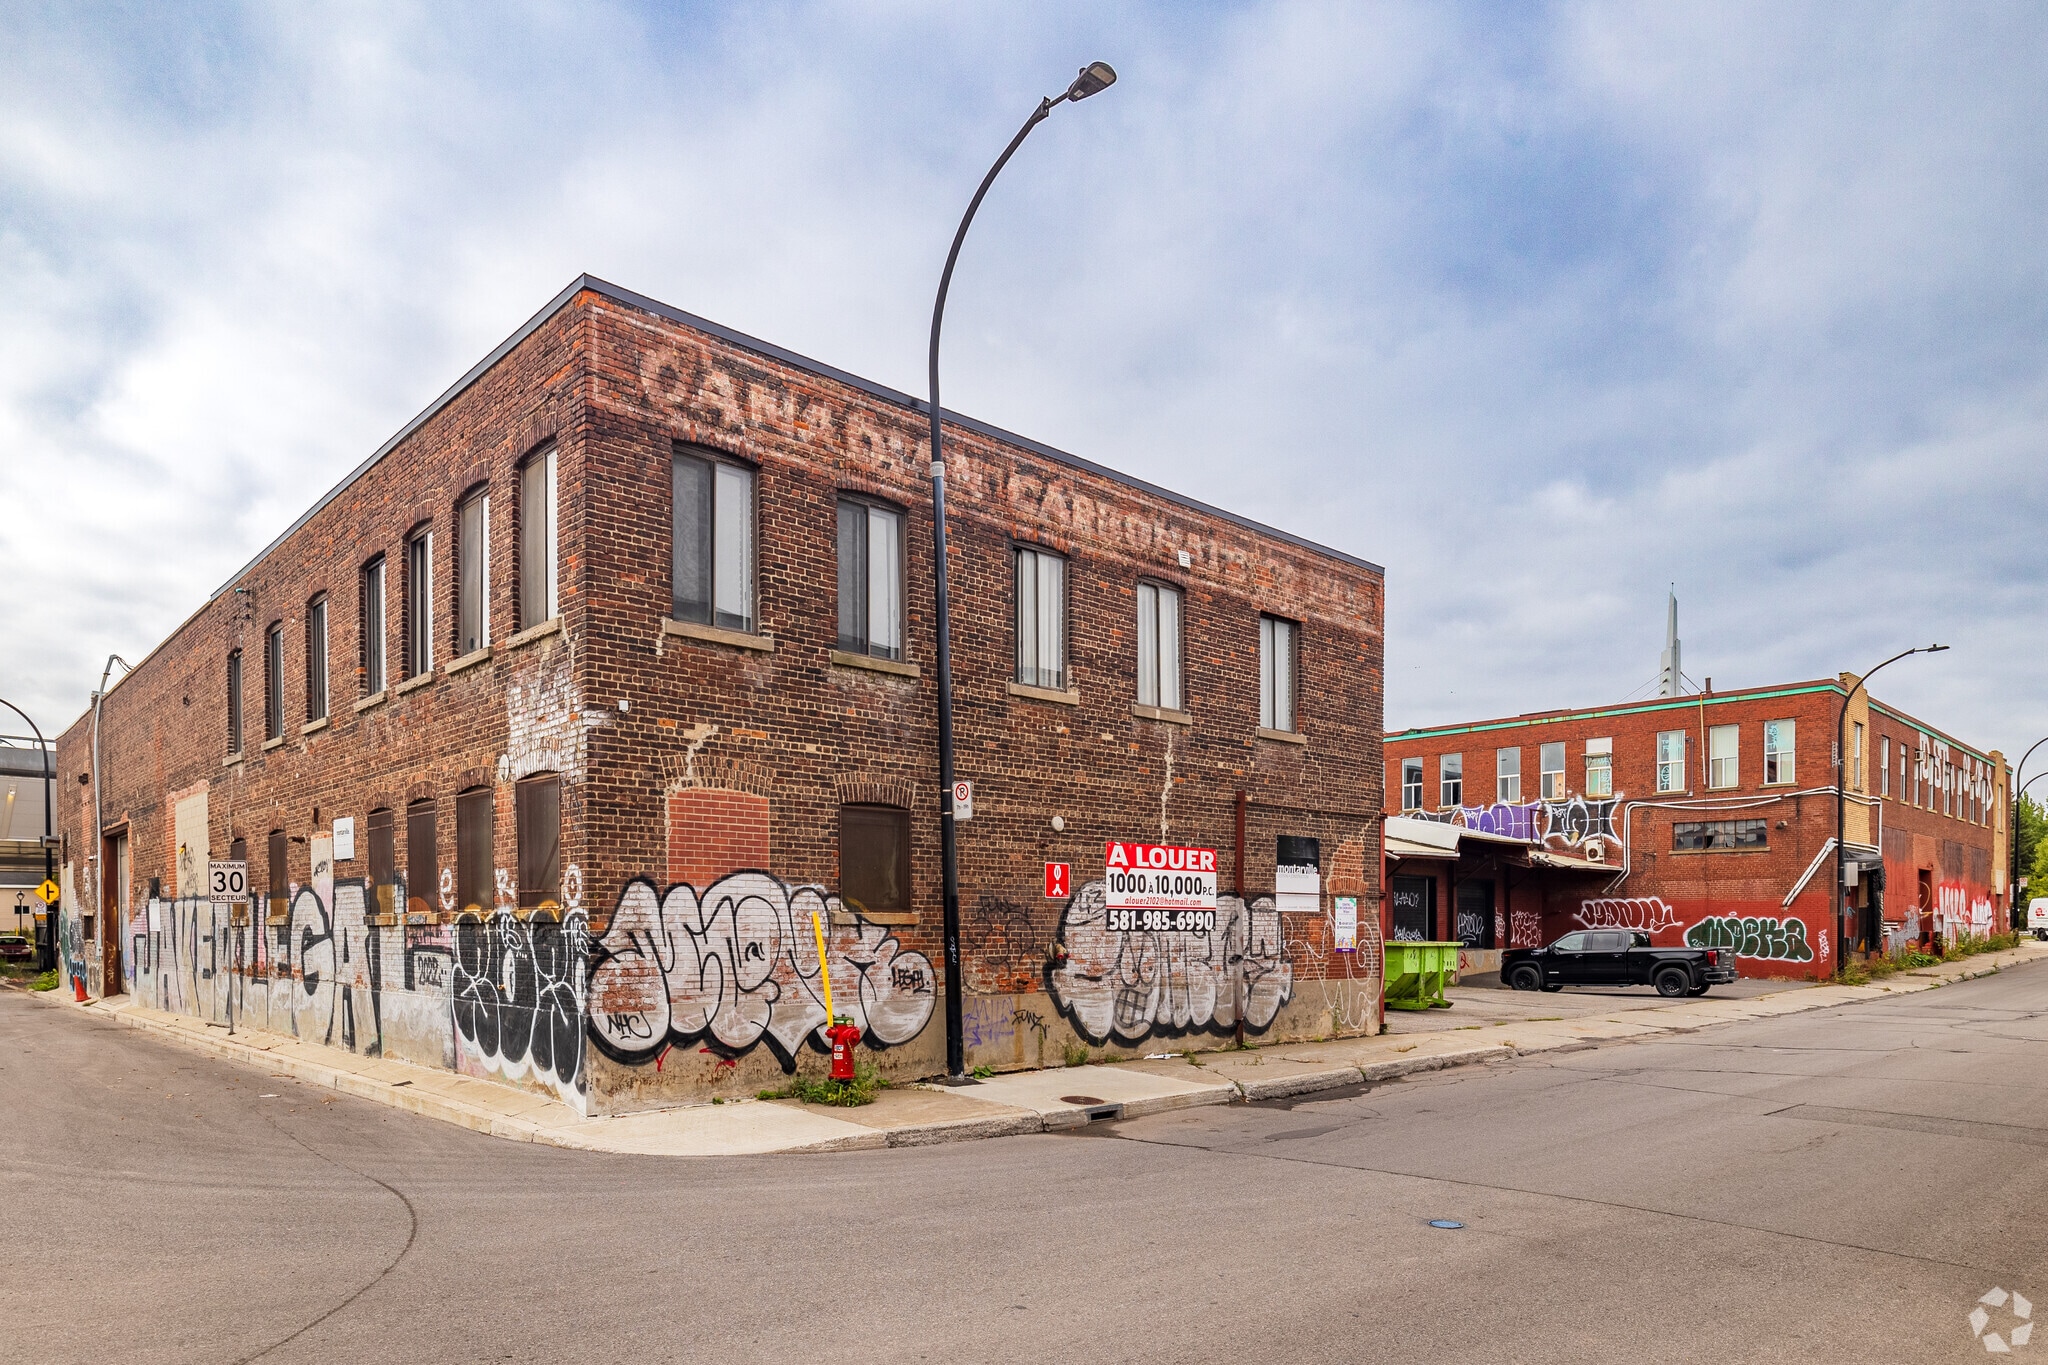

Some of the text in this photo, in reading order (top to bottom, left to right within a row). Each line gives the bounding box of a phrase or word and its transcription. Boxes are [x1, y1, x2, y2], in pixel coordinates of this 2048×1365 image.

[1136, 846, 1215, 871] LOUER
[213, 871, 244, 893] 30
[1109, 873, 1146, 893] 1000
[1155, 875, 1202, 898] 10,000
[1125, 896, 1202, 906] alouer2102@hotmail.com
[1109, 910, 1214, 931] 581-985-6990
